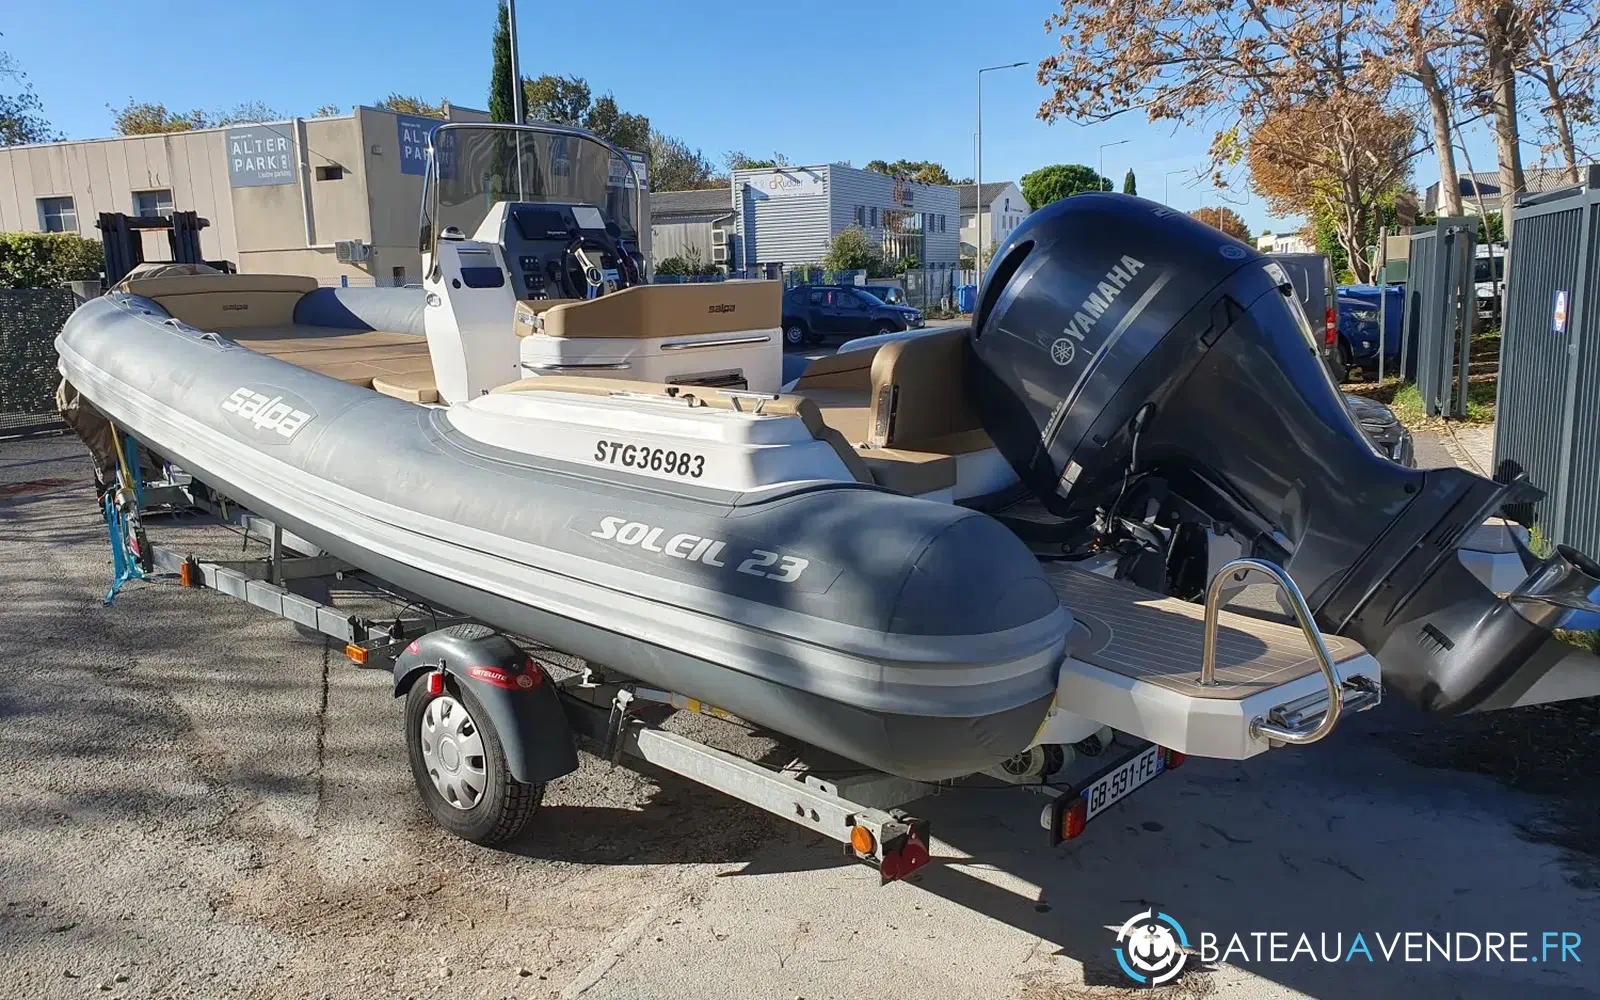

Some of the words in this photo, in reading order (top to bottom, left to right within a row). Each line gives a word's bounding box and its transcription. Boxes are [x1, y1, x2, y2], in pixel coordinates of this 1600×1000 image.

[233, 137, 287, 155] ALTER
[234, 155, 277, 172] PARK
[708, 303, 736, 314] salpa
[1063, 254, 1145, 341] YAMAHA
[221, 386, 314, 438] salpa
[594, 440, 705, 478] STG36983
[591, 516, 728, 568] SOLEIL
[736, 549, 810, 583] 23
[1090, 750, 1156, 813] GB-591-FE
